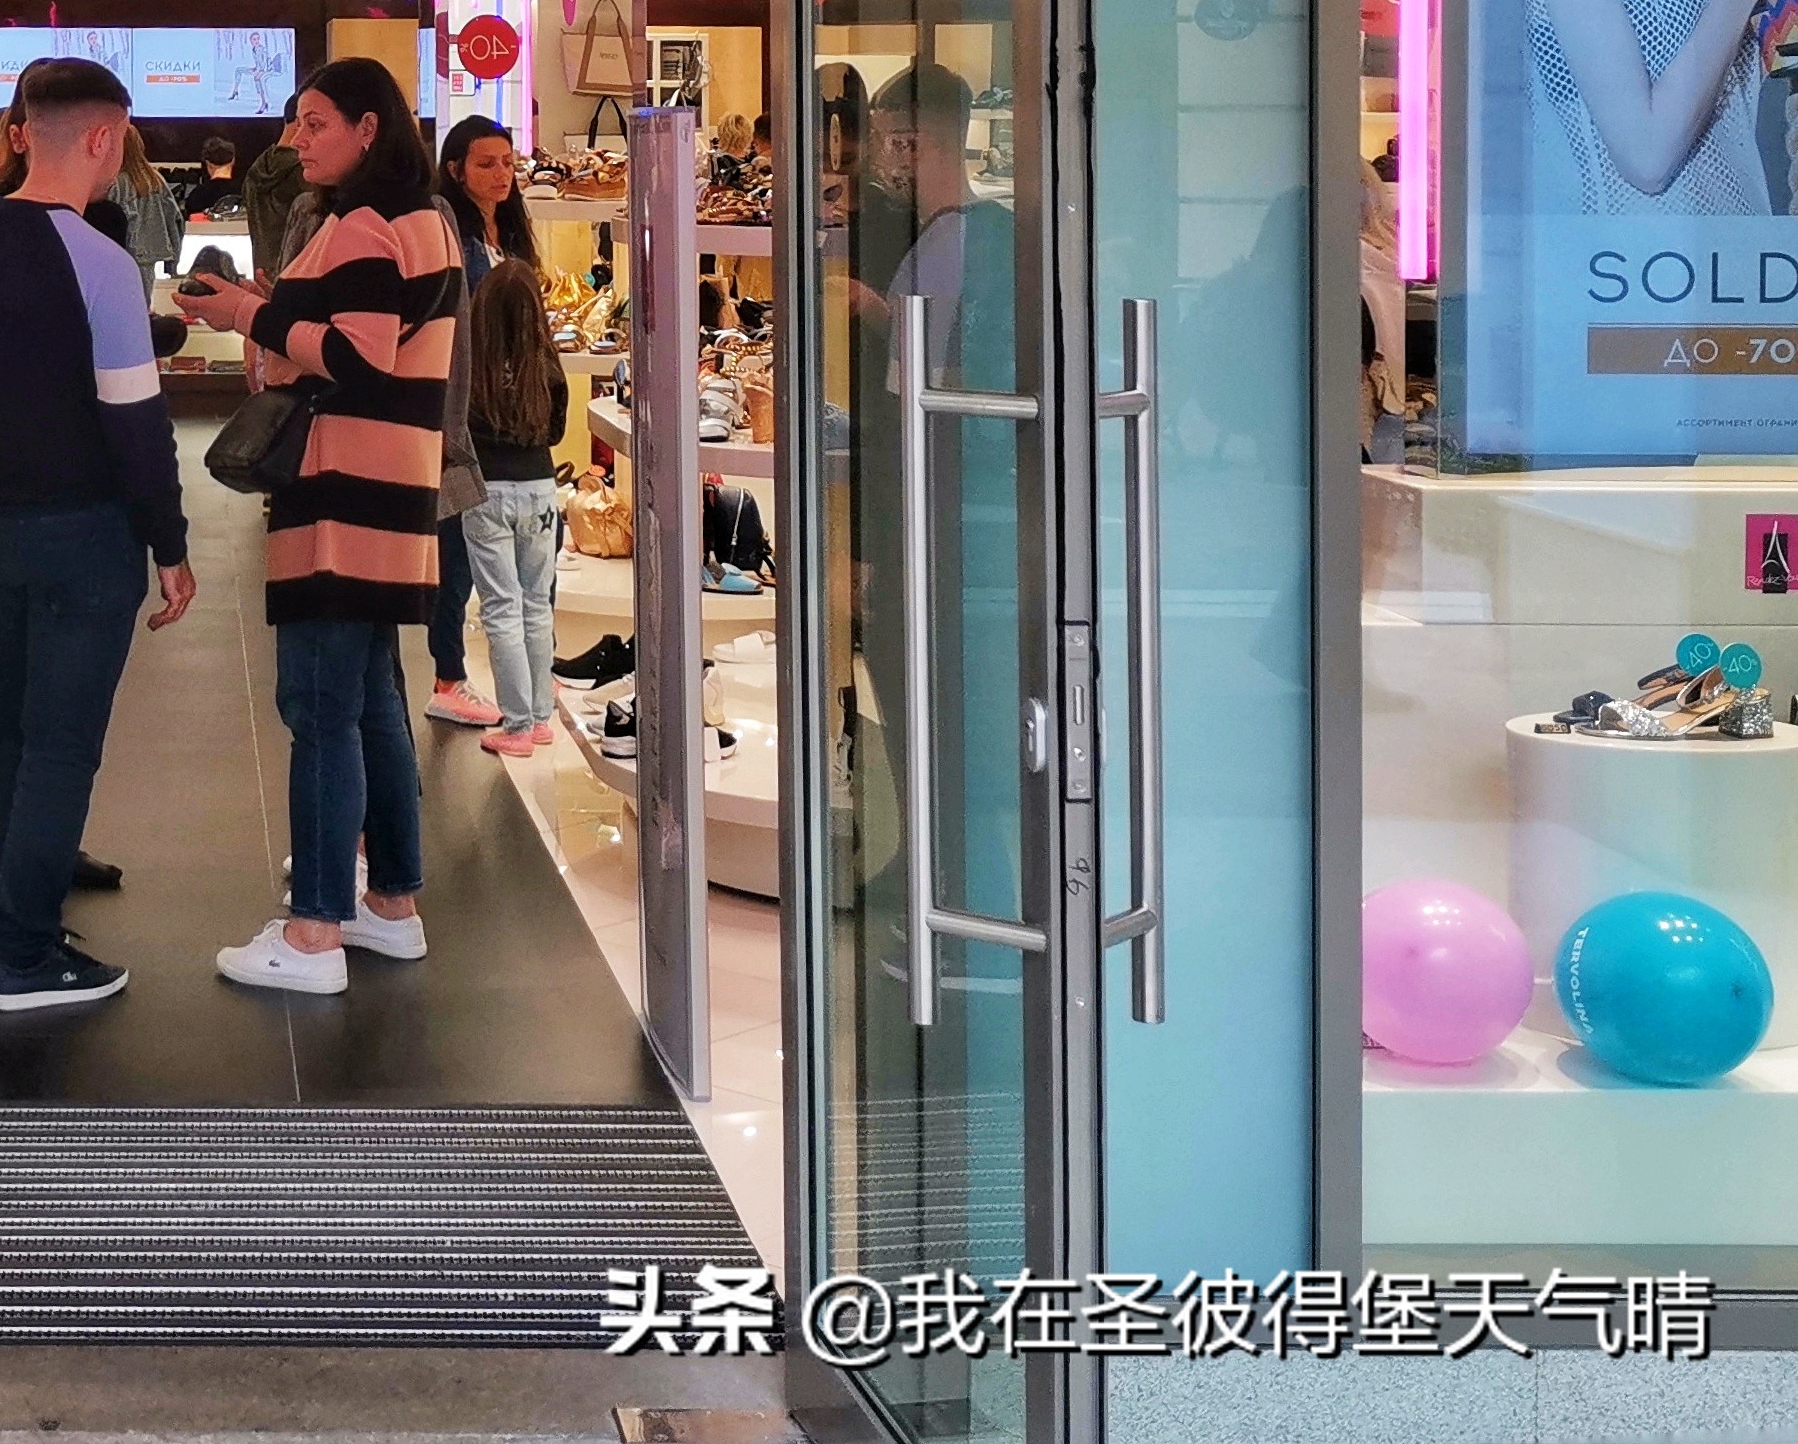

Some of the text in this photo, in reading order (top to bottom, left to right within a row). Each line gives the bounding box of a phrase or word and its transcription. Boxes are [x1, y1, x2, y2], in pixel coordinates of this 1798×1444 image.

[145, 60, 201, 72] СКИДКИ
[1664, 338, 1719, 368] ДО
[1677, 418, 1752, 427] АССОРТИМЕНТ
[1570, 926, 1594, 1033] TERVOLINA
